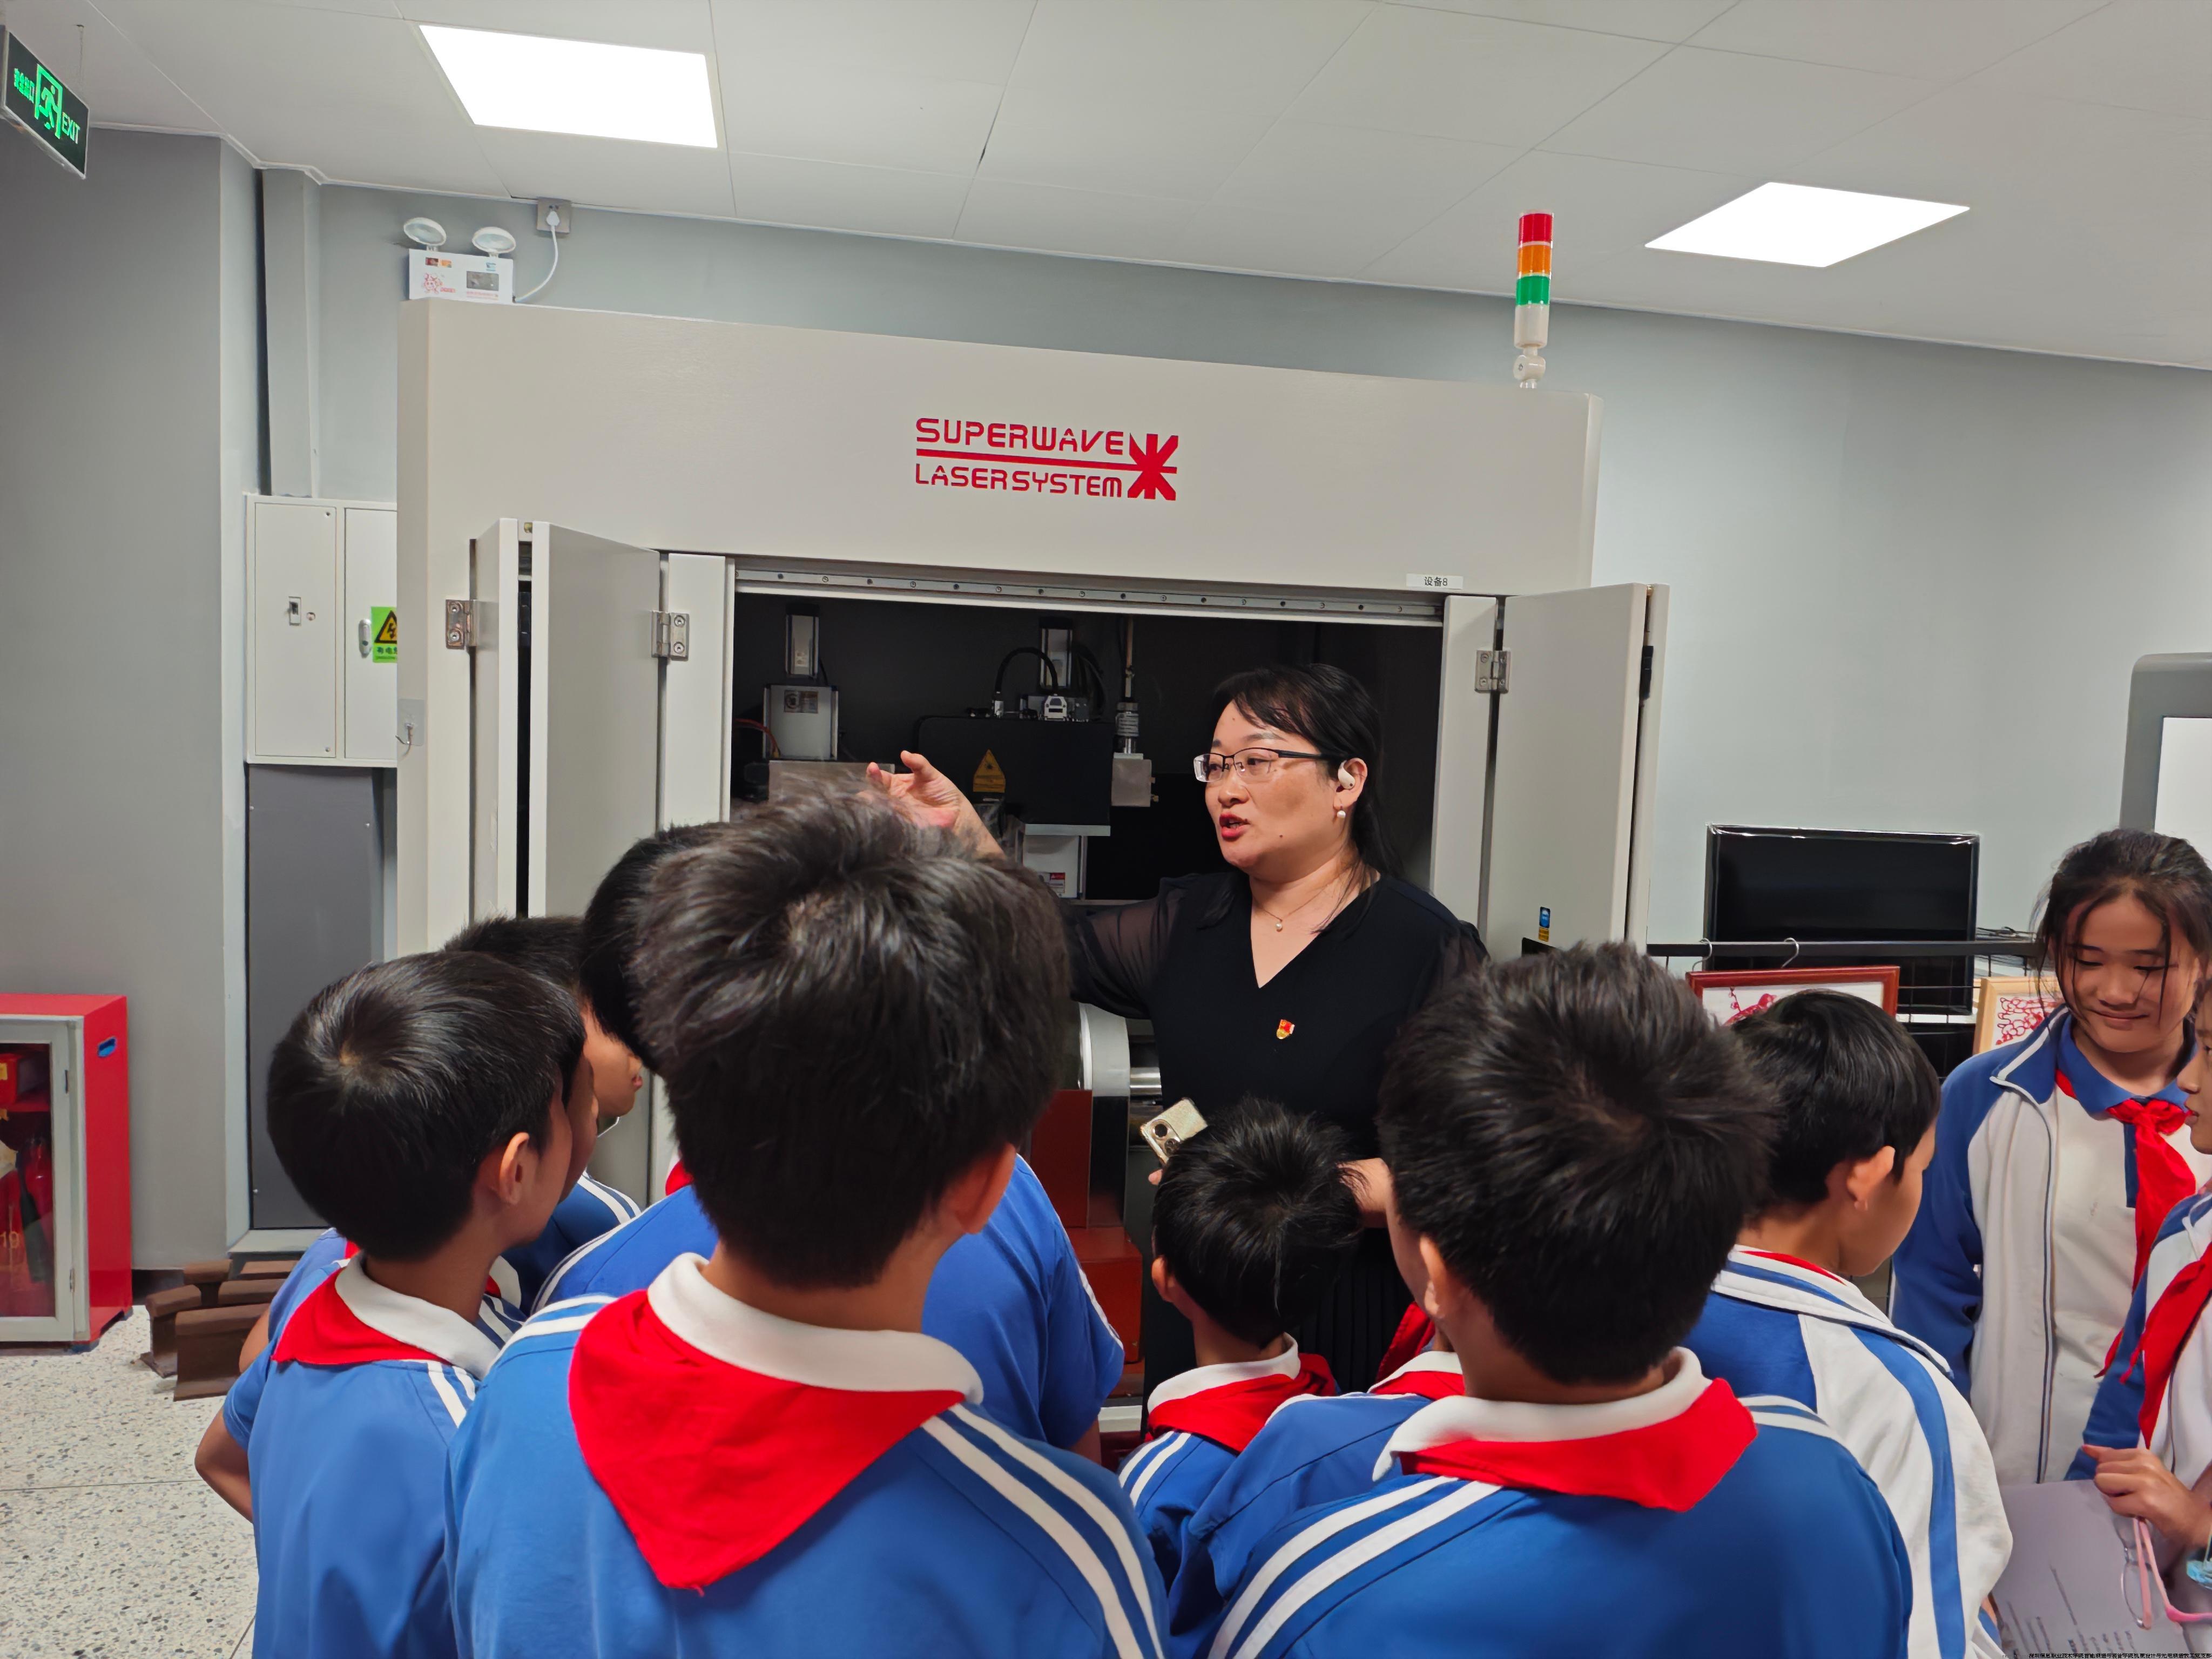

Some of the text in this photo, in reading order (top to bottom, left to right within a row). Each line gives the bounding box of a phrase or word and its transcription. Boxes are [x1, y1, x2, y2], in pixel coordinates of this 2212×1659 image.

[62, 112, 80, 144] EXIT
[916, 417, 1124, 455] SUPERWAVE
[1424, 576, 1448, 587] 设备8
